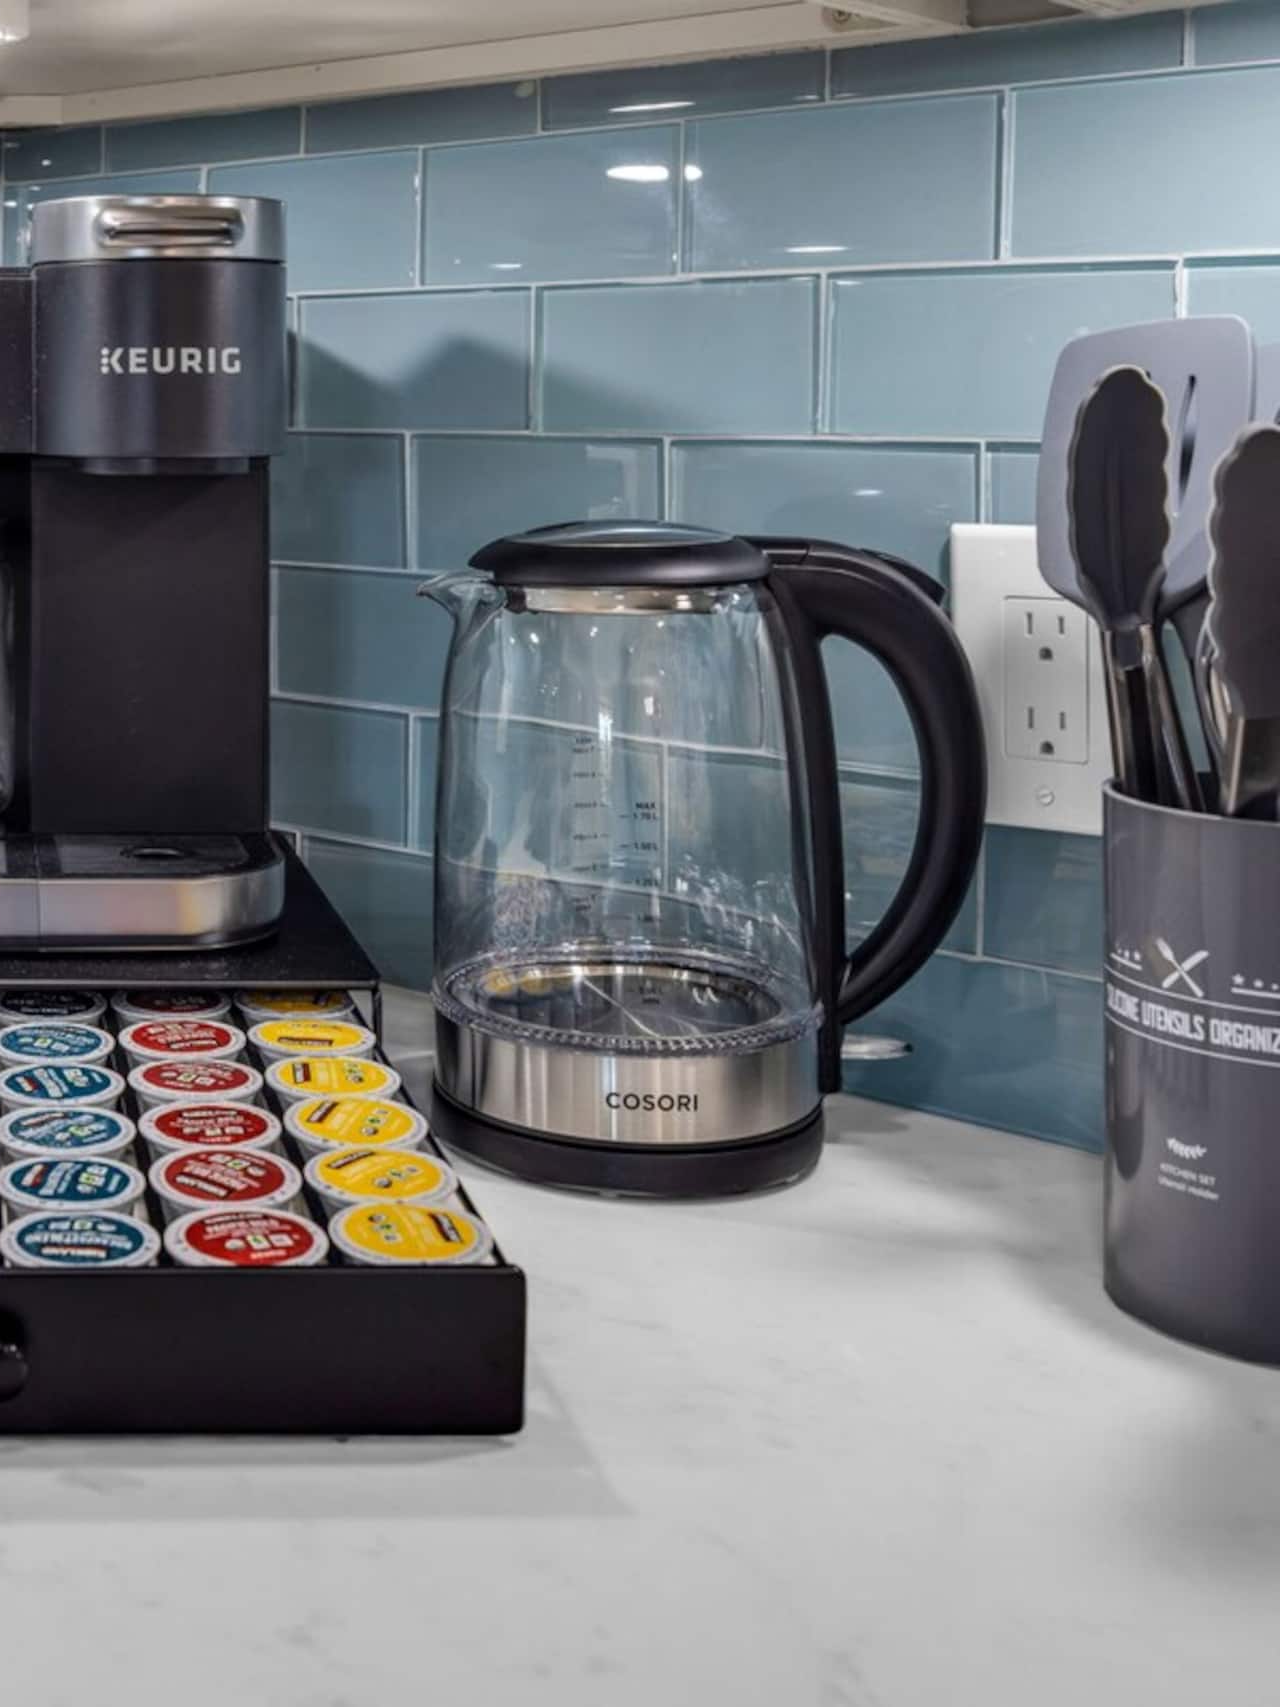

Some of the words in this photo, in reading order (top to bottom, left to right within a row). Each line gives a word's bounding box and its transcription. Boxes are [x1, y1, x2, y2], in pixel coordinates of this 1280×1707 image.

[101, 346, 241, 375] KEURIG
[1141, 1000, 1205, 1042] UTENSILS
[605, 1092, 698, 1112] COSORI
